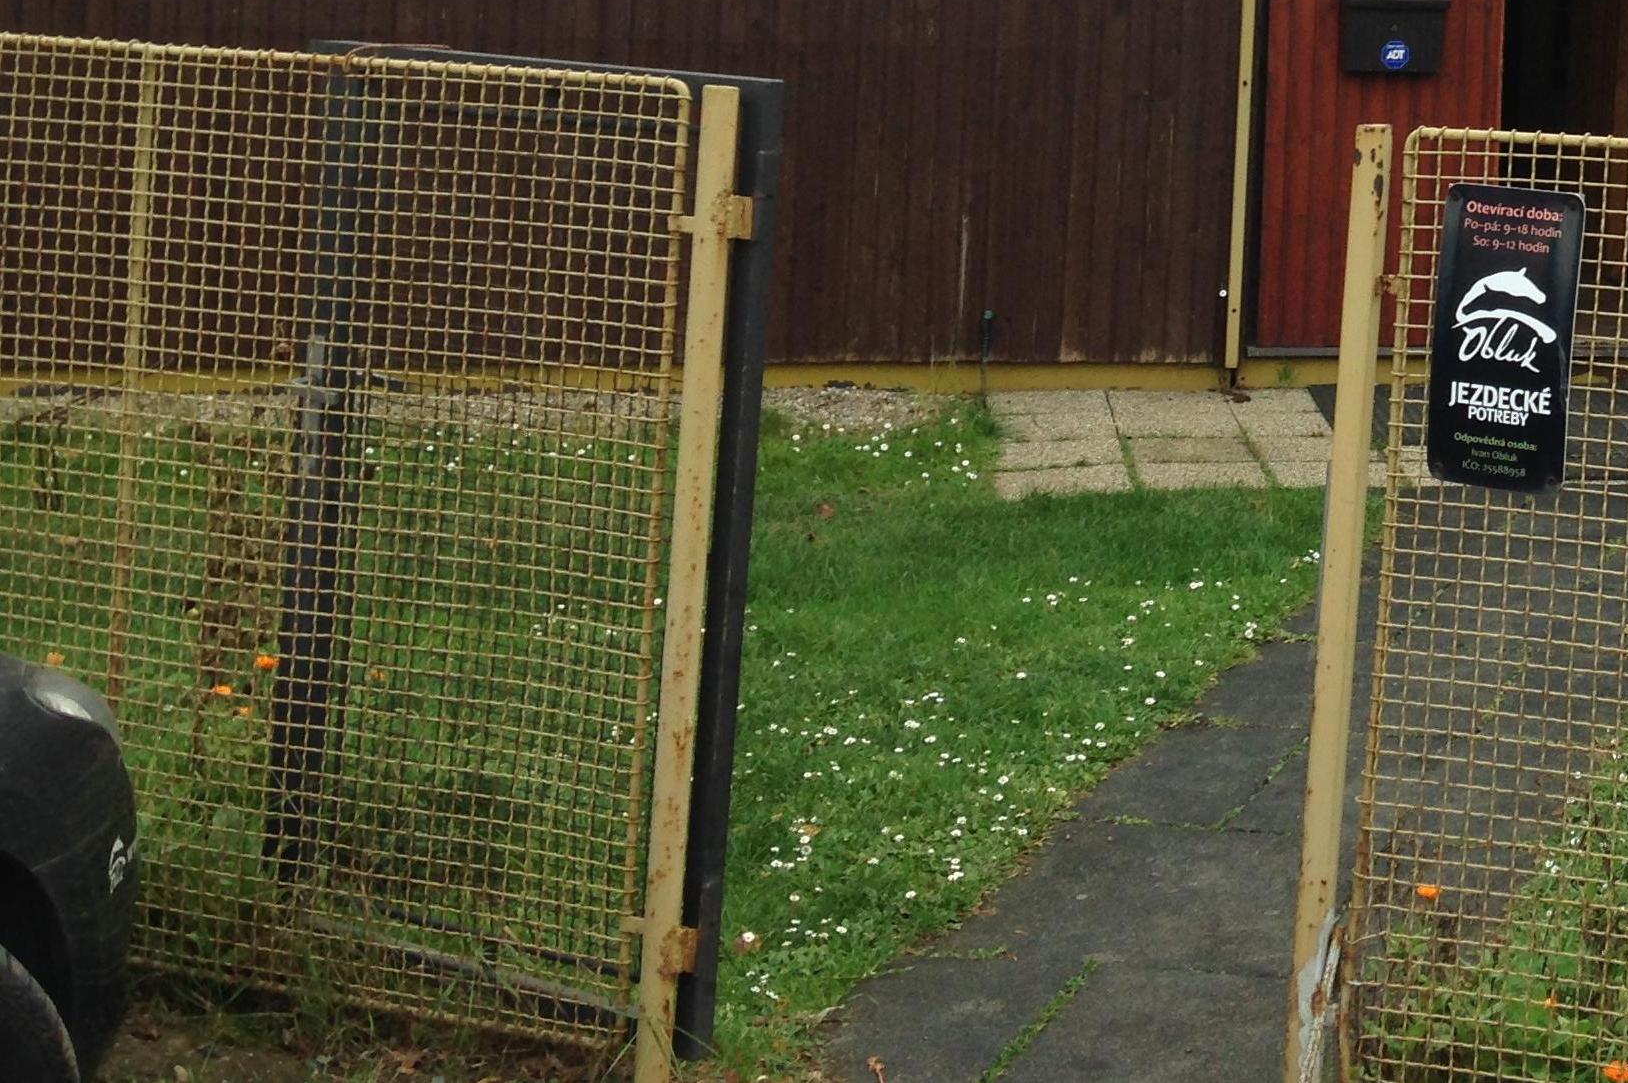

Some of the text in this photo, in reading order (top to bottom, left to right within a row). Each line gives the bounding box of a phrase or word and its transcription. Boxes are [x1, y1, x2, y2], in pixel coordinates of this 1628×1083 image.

[1386, 49, 1405, 60] ADT
[1466, 200, 1564, 222] Otevírací doba:
[1530, 225, 1563, 239] hodin
[1473, 235, 1490, 247] So:
[1518, 242, 1550, 254] hodin
[1458, 319, 1541, 373] Obluk
[1448, 381, 1552, 416] JEZDECKÉ
[1507, 438, 1538, 452] osoba:
